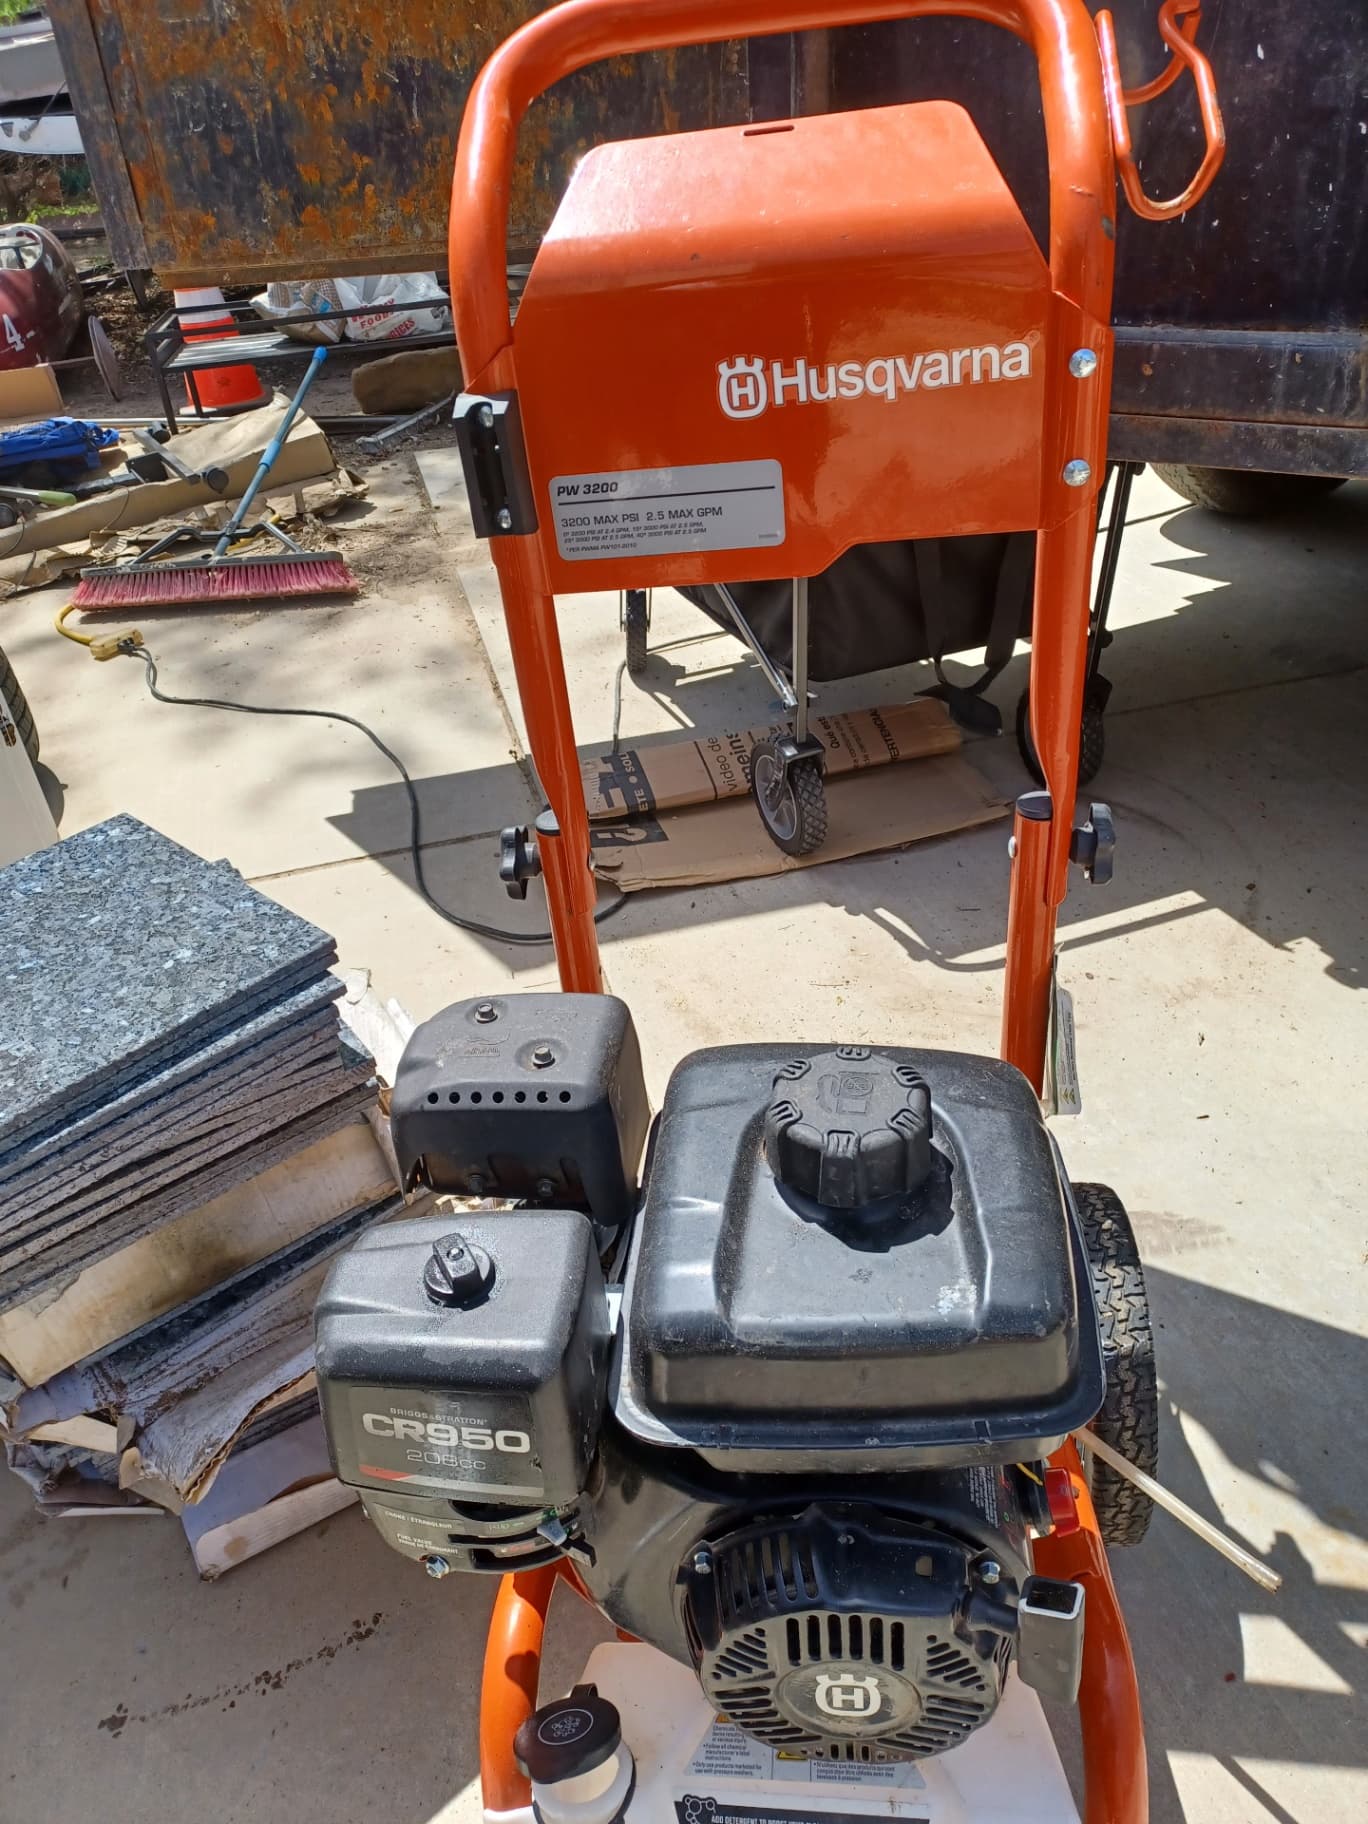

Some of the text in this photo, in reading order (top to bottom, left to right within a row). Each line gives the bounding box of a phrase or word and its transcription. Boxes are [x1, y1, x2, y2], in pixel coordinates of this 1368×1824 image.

[2, 314, 25, 352] 4
[771, 342, 1031, 405] Husqvarna
[557, 482, 618, 496] PW 3200
[561, 506, 723, 528] 3200 MAX PSI 2.5 MAX GPM
[825, 731, 840, 750] Qué
[869, 707, 900, 761] ERTENCIA
[707, 736, 738, 792] video de
[634, 788, 649, 812] ETE
[362, 1412, 531, 1454] CR950
[406, 1449, 487, 1470] 208cc
